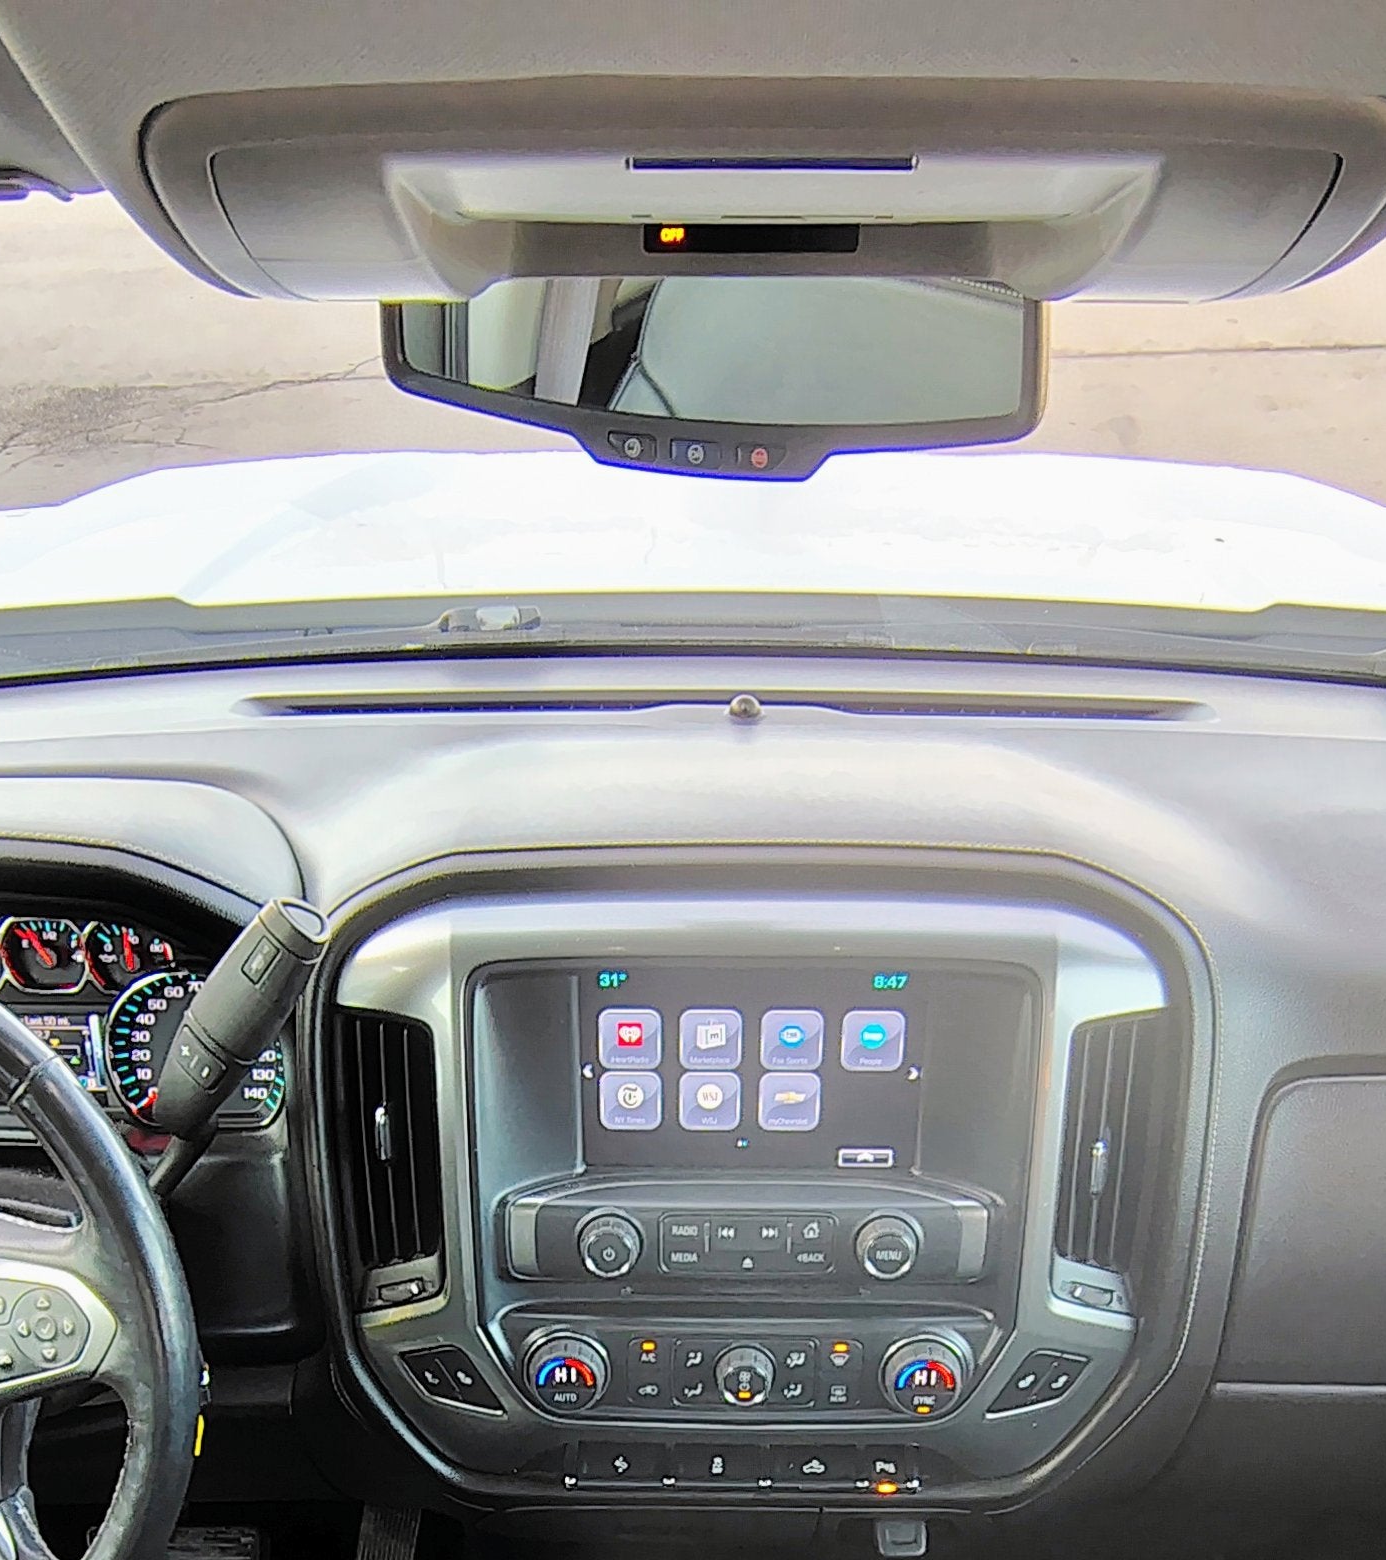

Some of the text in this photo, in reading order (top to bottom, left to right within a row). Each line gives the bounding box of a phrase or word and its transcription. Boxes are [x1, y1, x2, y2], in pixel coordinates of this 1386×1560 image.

[660, 227, 685, 242] OFF
[186, 981, 205, 992] 70
[873, 973, 908, 990] 8:47
[164, 986, 184, 998] 60
[148, 999, 167, 1010] 50
[135, 1013, 155, 1025] 40
[131, 1031, 150, 1042] 30
[131, 1050, 151, 1061] 20
[136, 1068, 152, 1079] 10
[252, 1069, 275, 1081] 130
[244, 1087, 268, 1099] 140
[671, 1226, 699, 1237] RADIO
[671, 1252, 699, 1263] MEDIA
[803, 1252, 825, 1263] BACK
[876, 1250, 903, 1262] MENU
[640, 1352, 657, 1363] A/C
[554, 1367, 578, 1383] HI
[914, 1370, 938, 1387] HI
[553, 1392, 578, 1403] AUTO
[913, 1395, 937, 1406] SYNC
